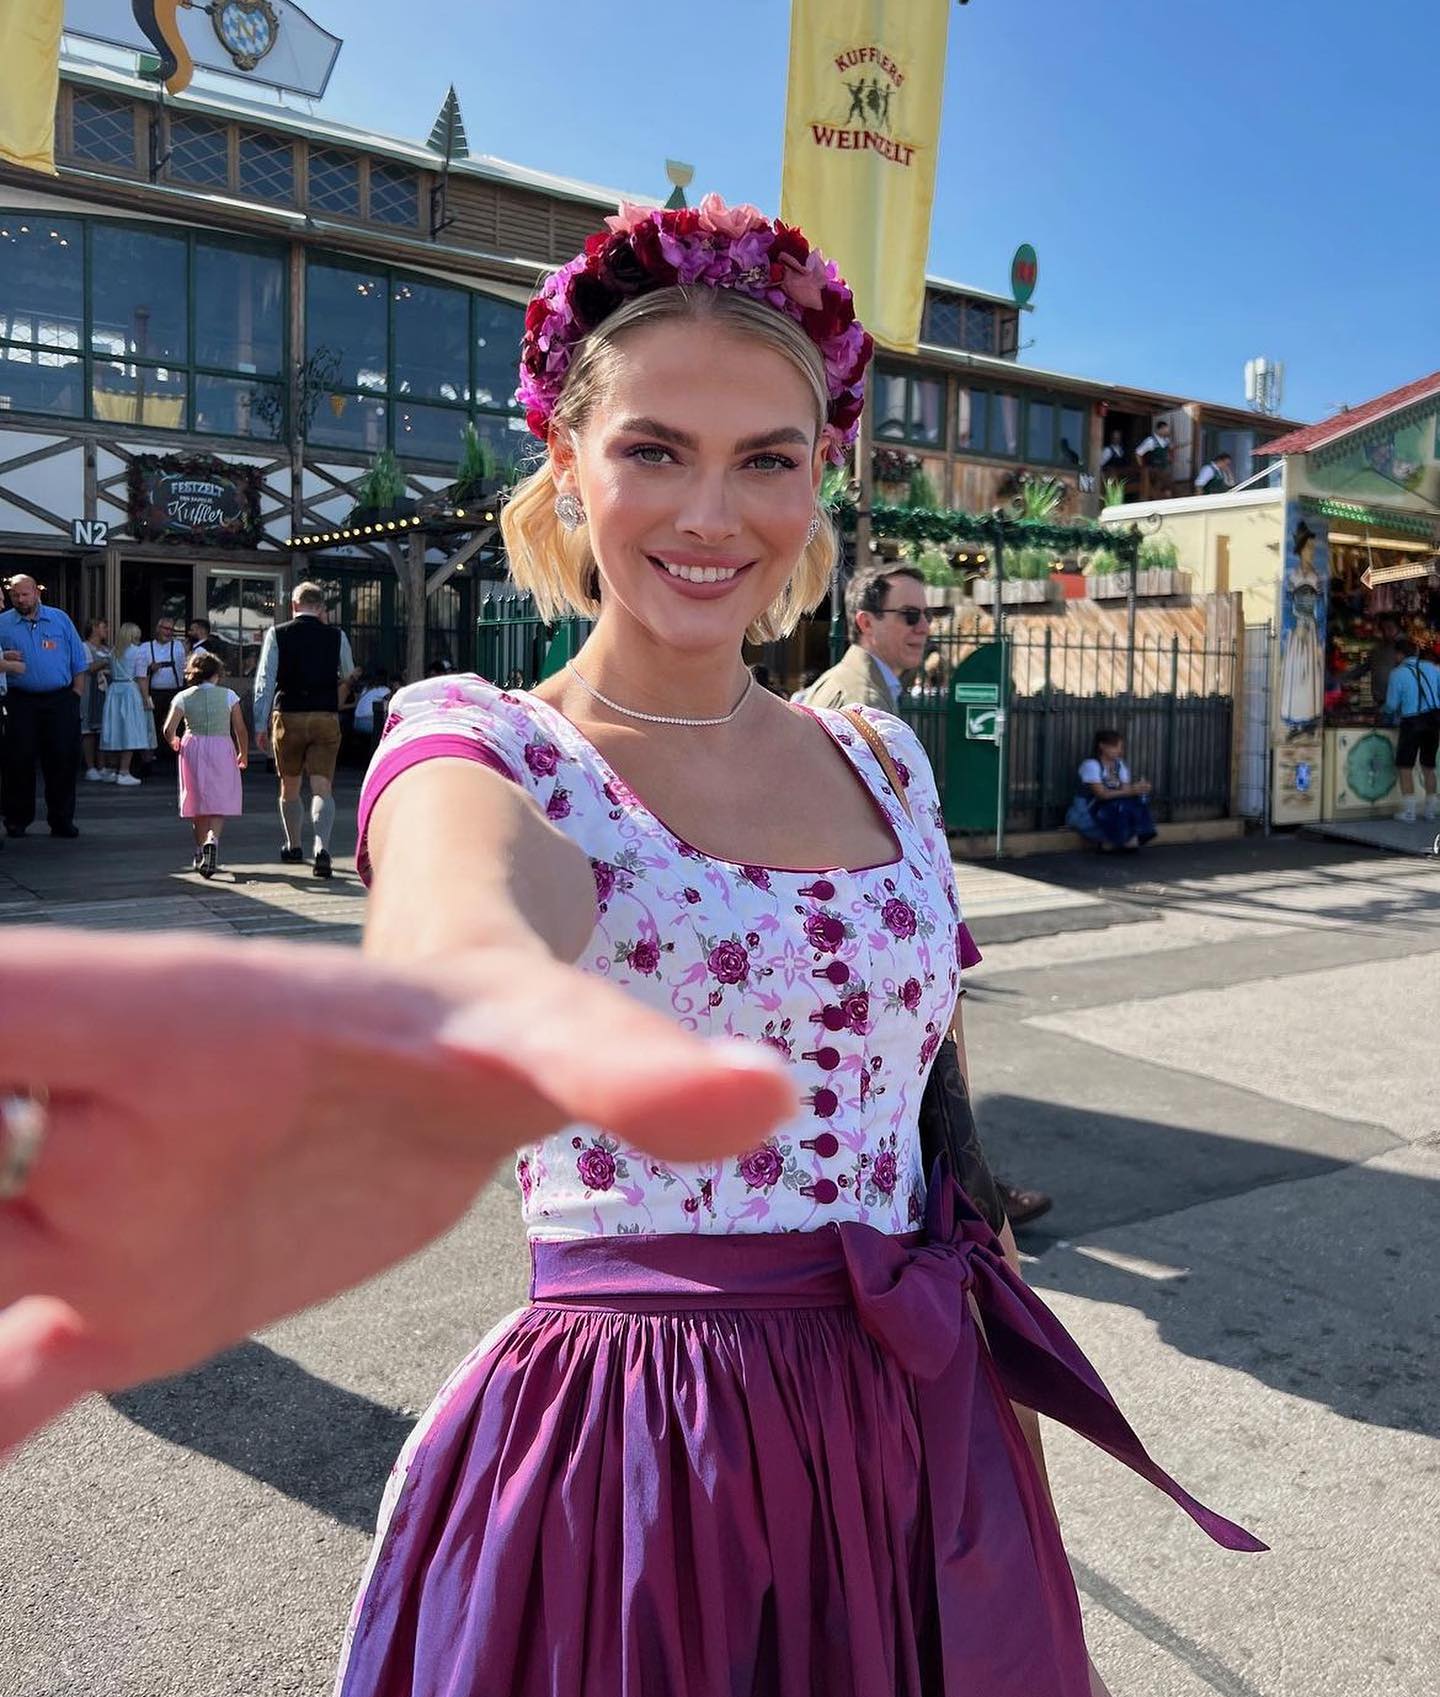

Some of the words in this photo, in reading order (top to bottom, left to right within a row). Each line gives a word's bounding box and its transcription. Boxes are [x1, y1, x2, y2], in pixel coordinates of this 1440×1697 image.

[171, 481, 225, 497] FESTZELT
[167, 500, 228, 527] Kuffler
[75, 520, 108, 546] N2
